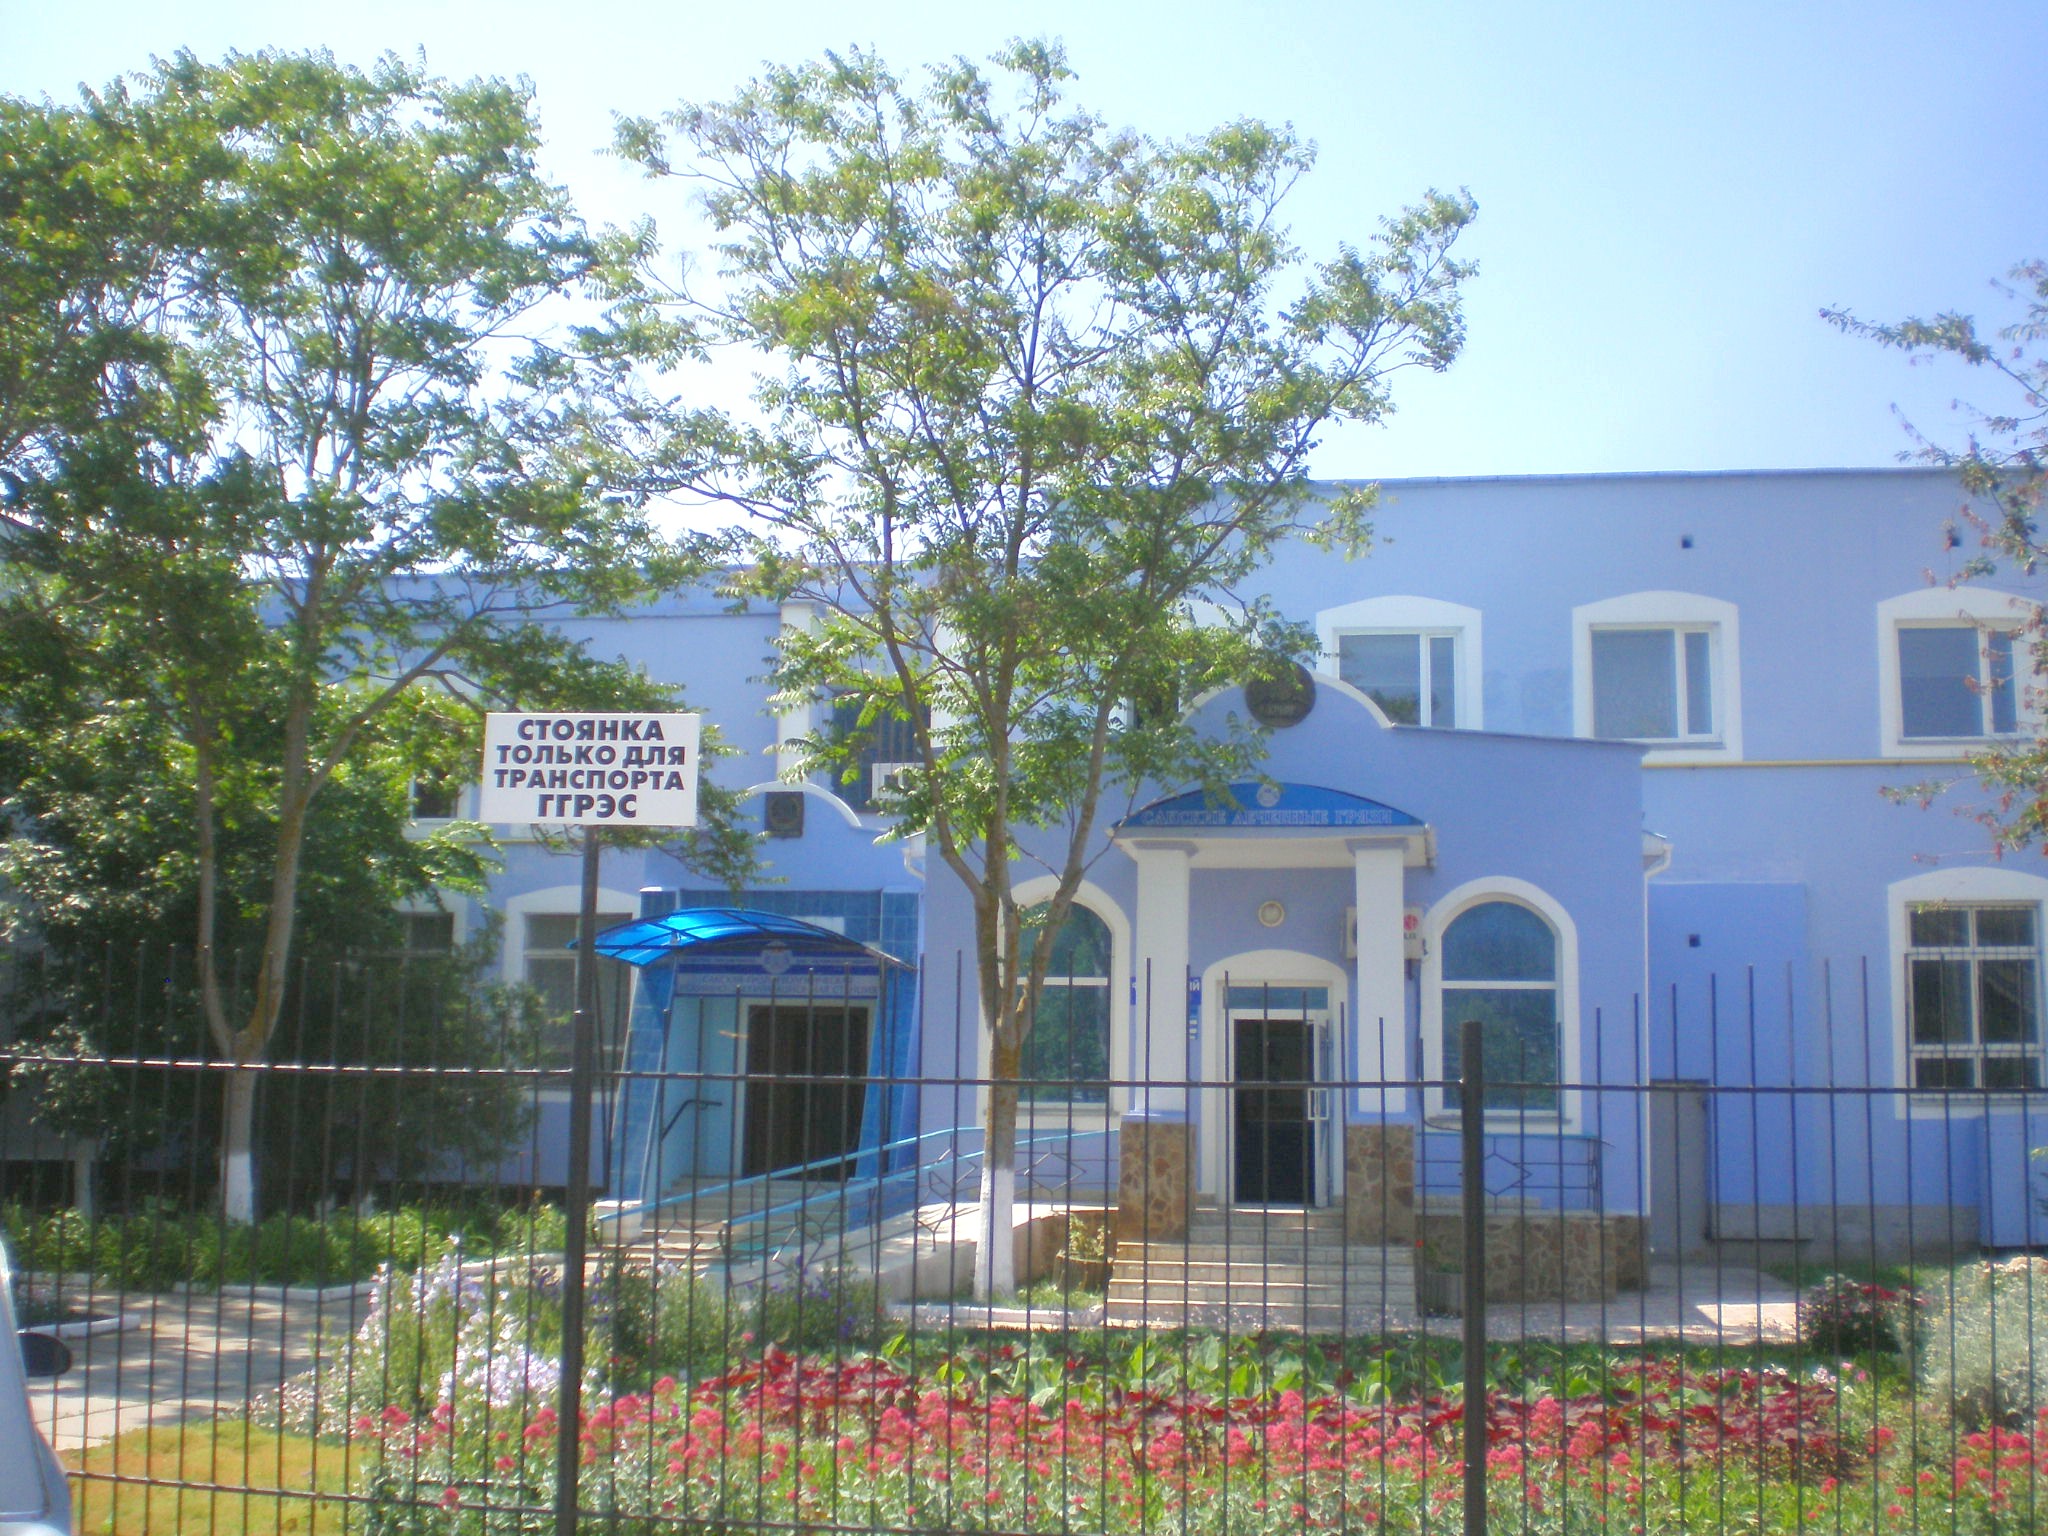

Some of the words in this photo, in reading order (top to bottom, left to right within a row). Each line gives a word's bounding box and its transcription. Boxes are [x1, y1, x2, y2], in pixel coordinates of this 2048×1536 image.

[517, 719, 664, 741] СТОЯНКА
[496, 744, 616, 765] ТОЛЬКО
[622, 745, 685, 769] ДЛЯ
[494, 769, 685, 790] ТРАНСПОРТА
[537, 793, 638, 818] ГГРЭС
